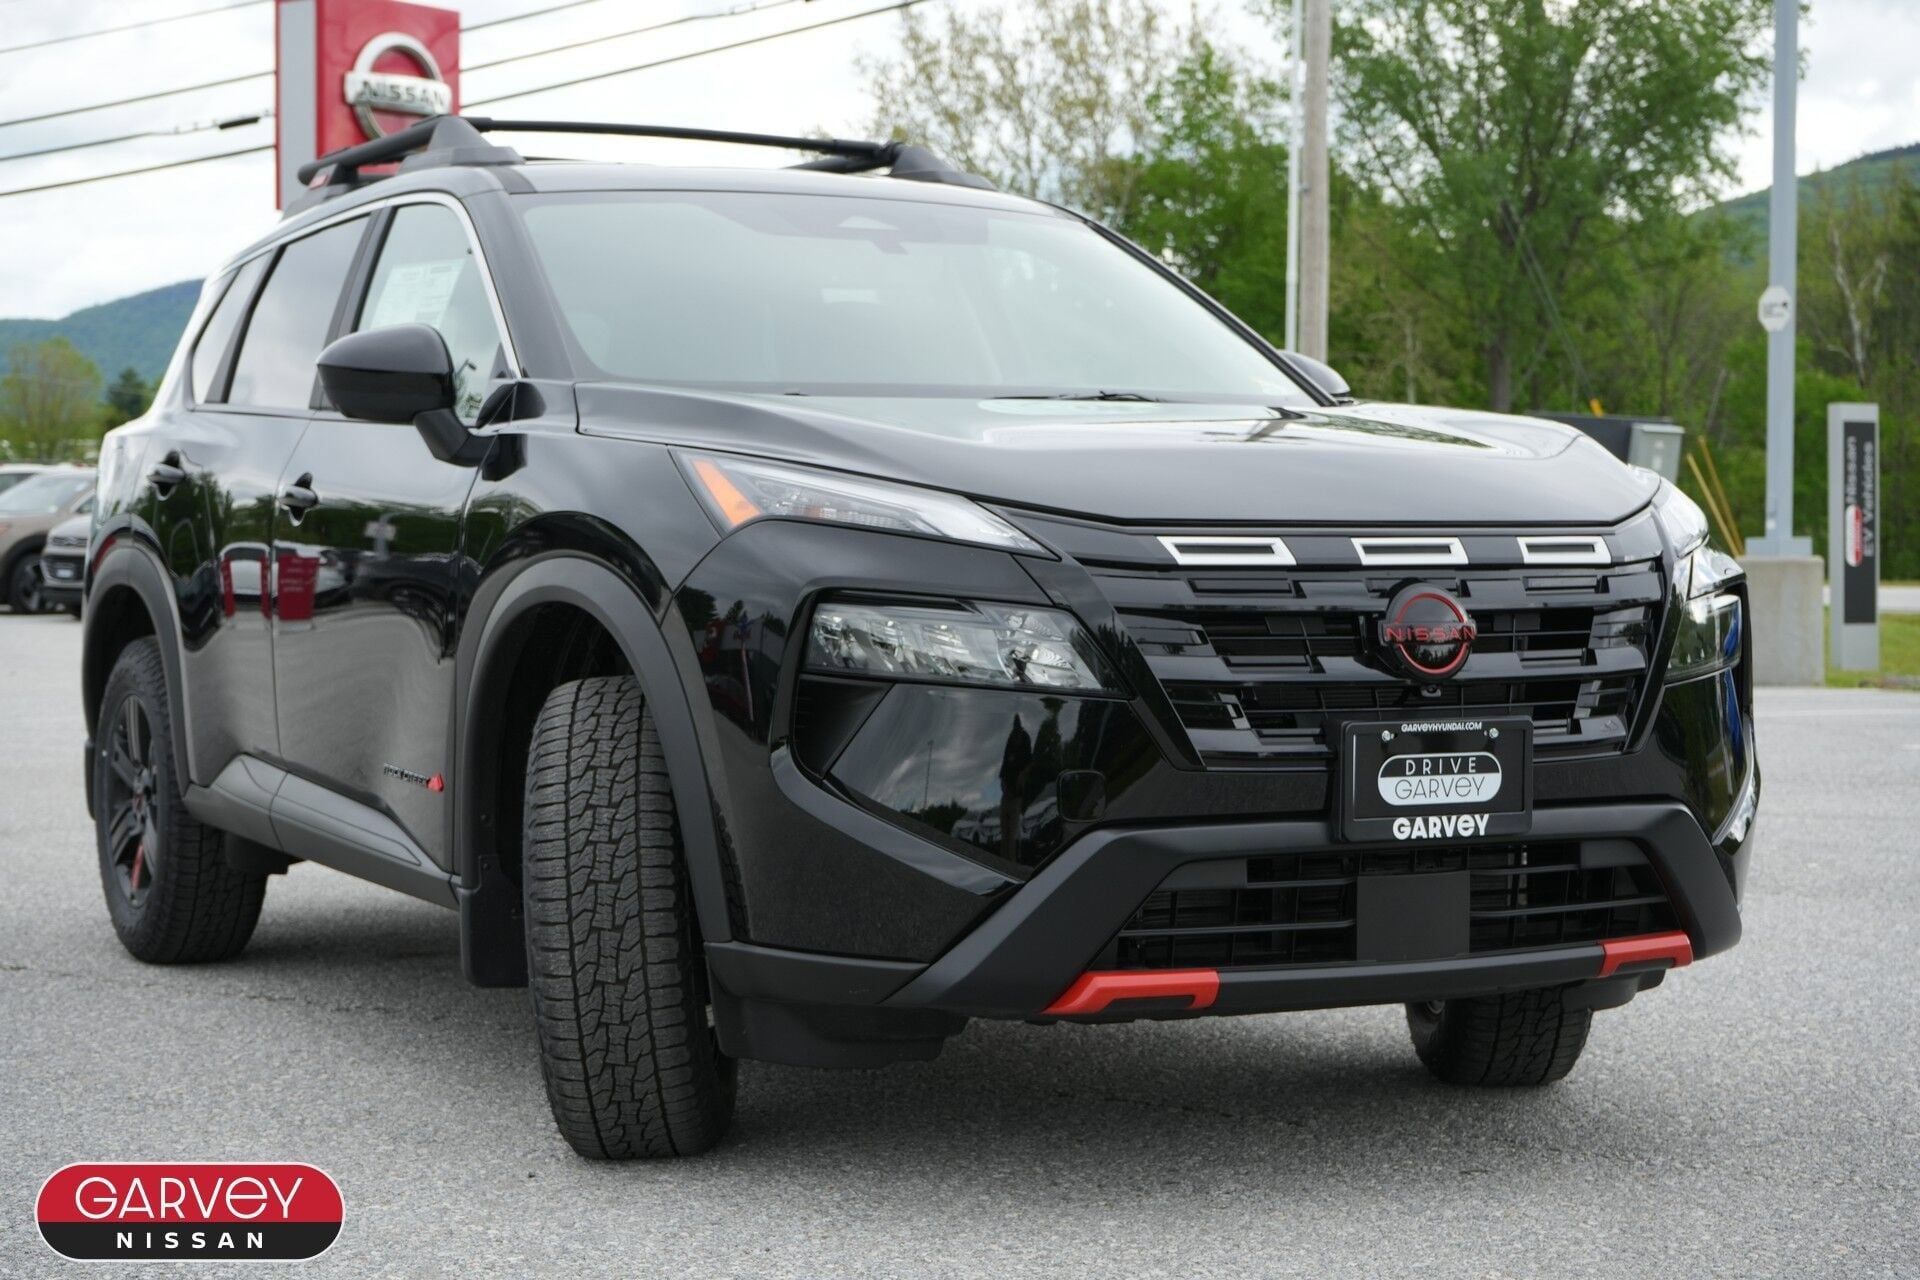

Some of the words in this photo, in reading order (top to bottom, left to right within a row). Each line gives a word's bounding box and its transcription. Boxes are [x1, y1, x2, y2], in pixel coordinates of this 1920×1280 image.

[359, 80, 445, 106] NISSAN
[1385, 625, 1477, 642] NISSAN
[1405, 757, 1477, 776] DRIVE
